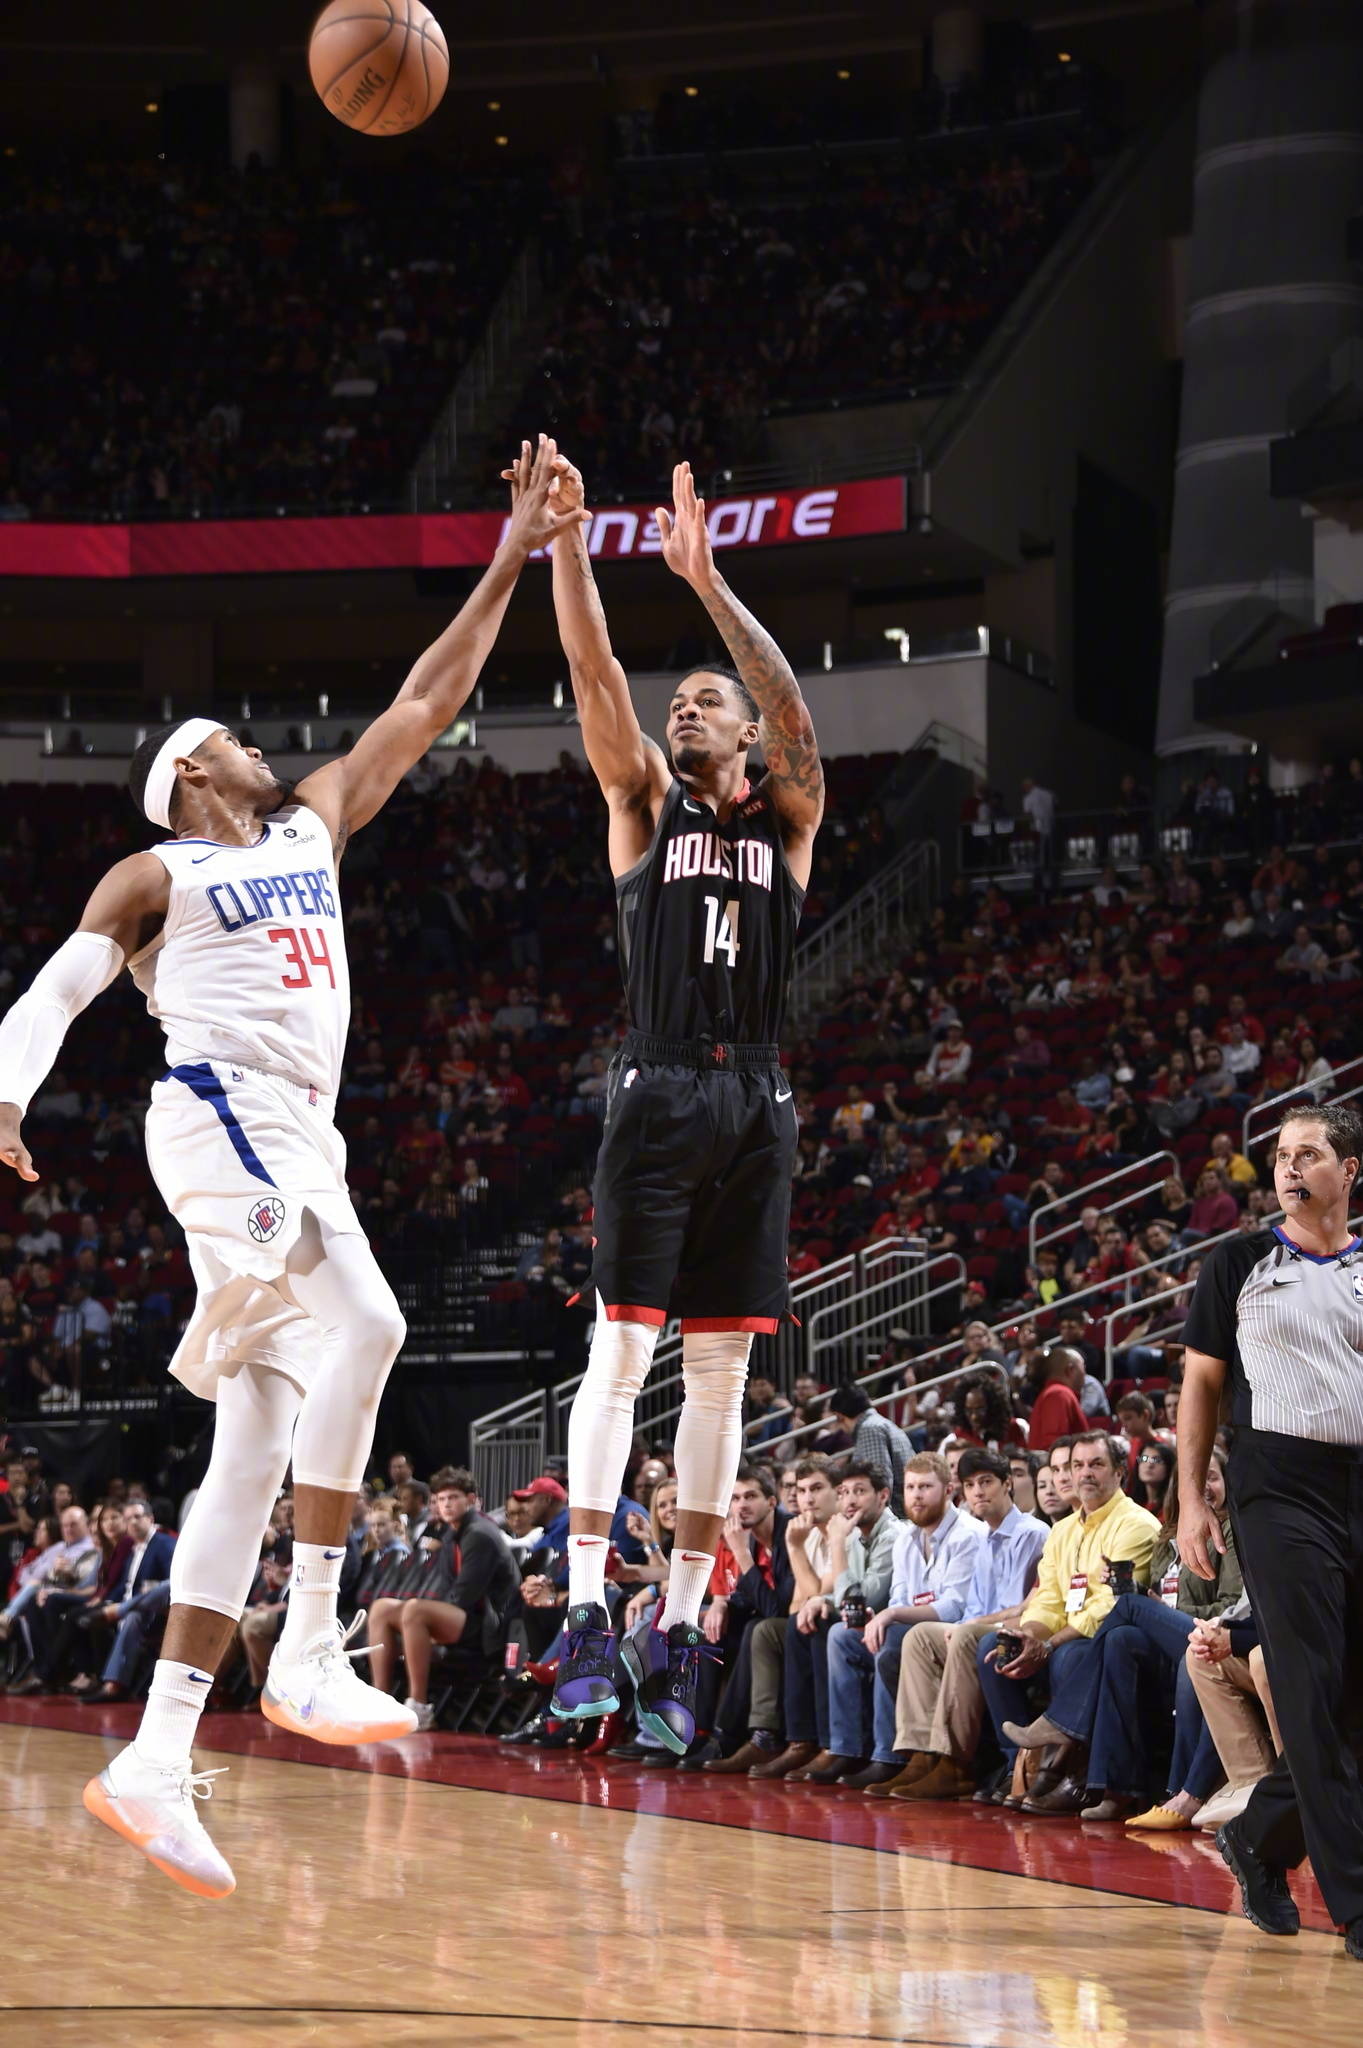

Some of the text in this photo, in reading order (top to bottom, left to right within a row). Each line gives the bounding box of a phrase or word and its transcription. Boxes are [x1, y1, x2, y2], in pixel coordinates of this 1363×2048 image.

[663, 832, 774, 893] HOUSTON
[206, 867, 336, 932] CLIPPERS
[703, 895, 740, 967] 14
[267, 927, 336, 989] 34
